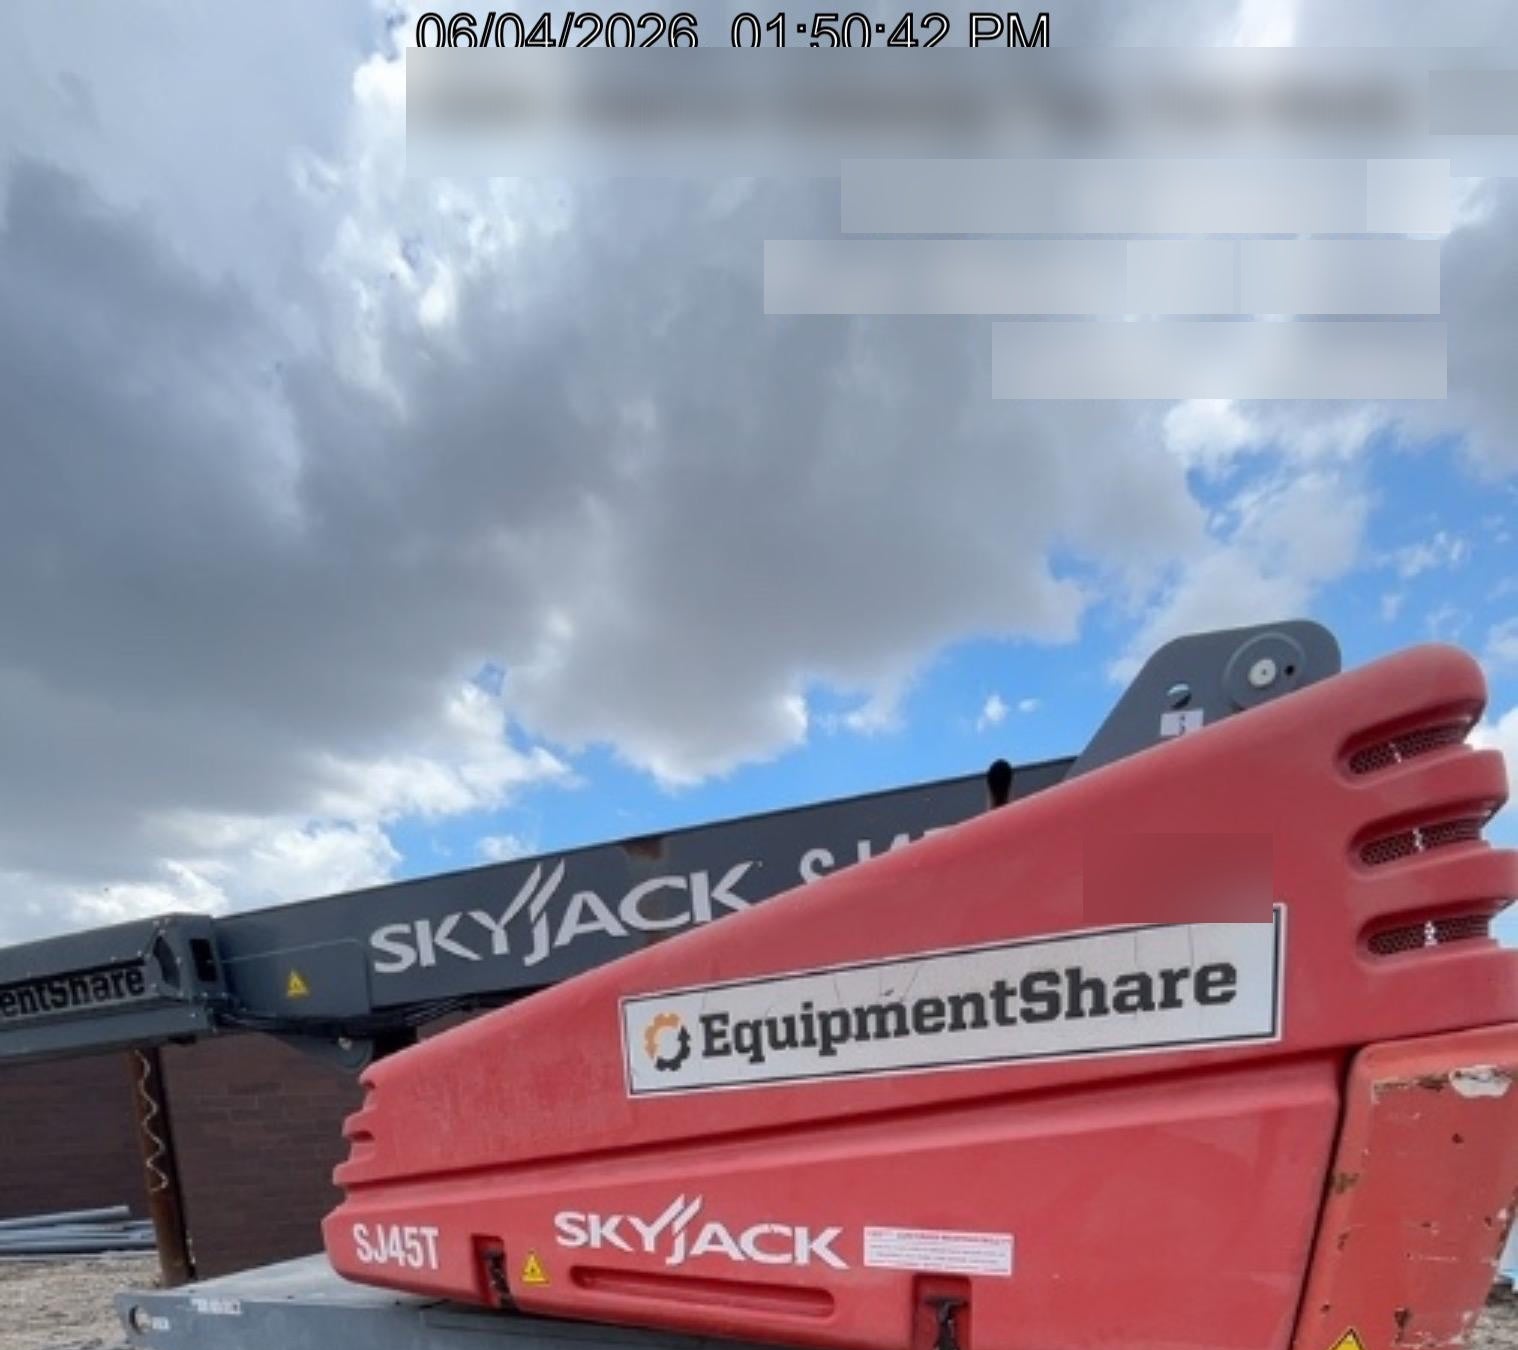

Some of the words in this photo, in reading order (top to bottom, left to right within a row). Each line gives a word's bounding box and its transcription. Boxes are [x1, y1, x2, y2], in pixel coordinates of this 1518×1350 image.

[370, 860, 754, 973] SKYJACK
[700, 961, 1237, 1064] EquipmentShare
[353, 1223, 439, 1270] SJ45T
[554, 1194, 848, 1268] SKYJACK
